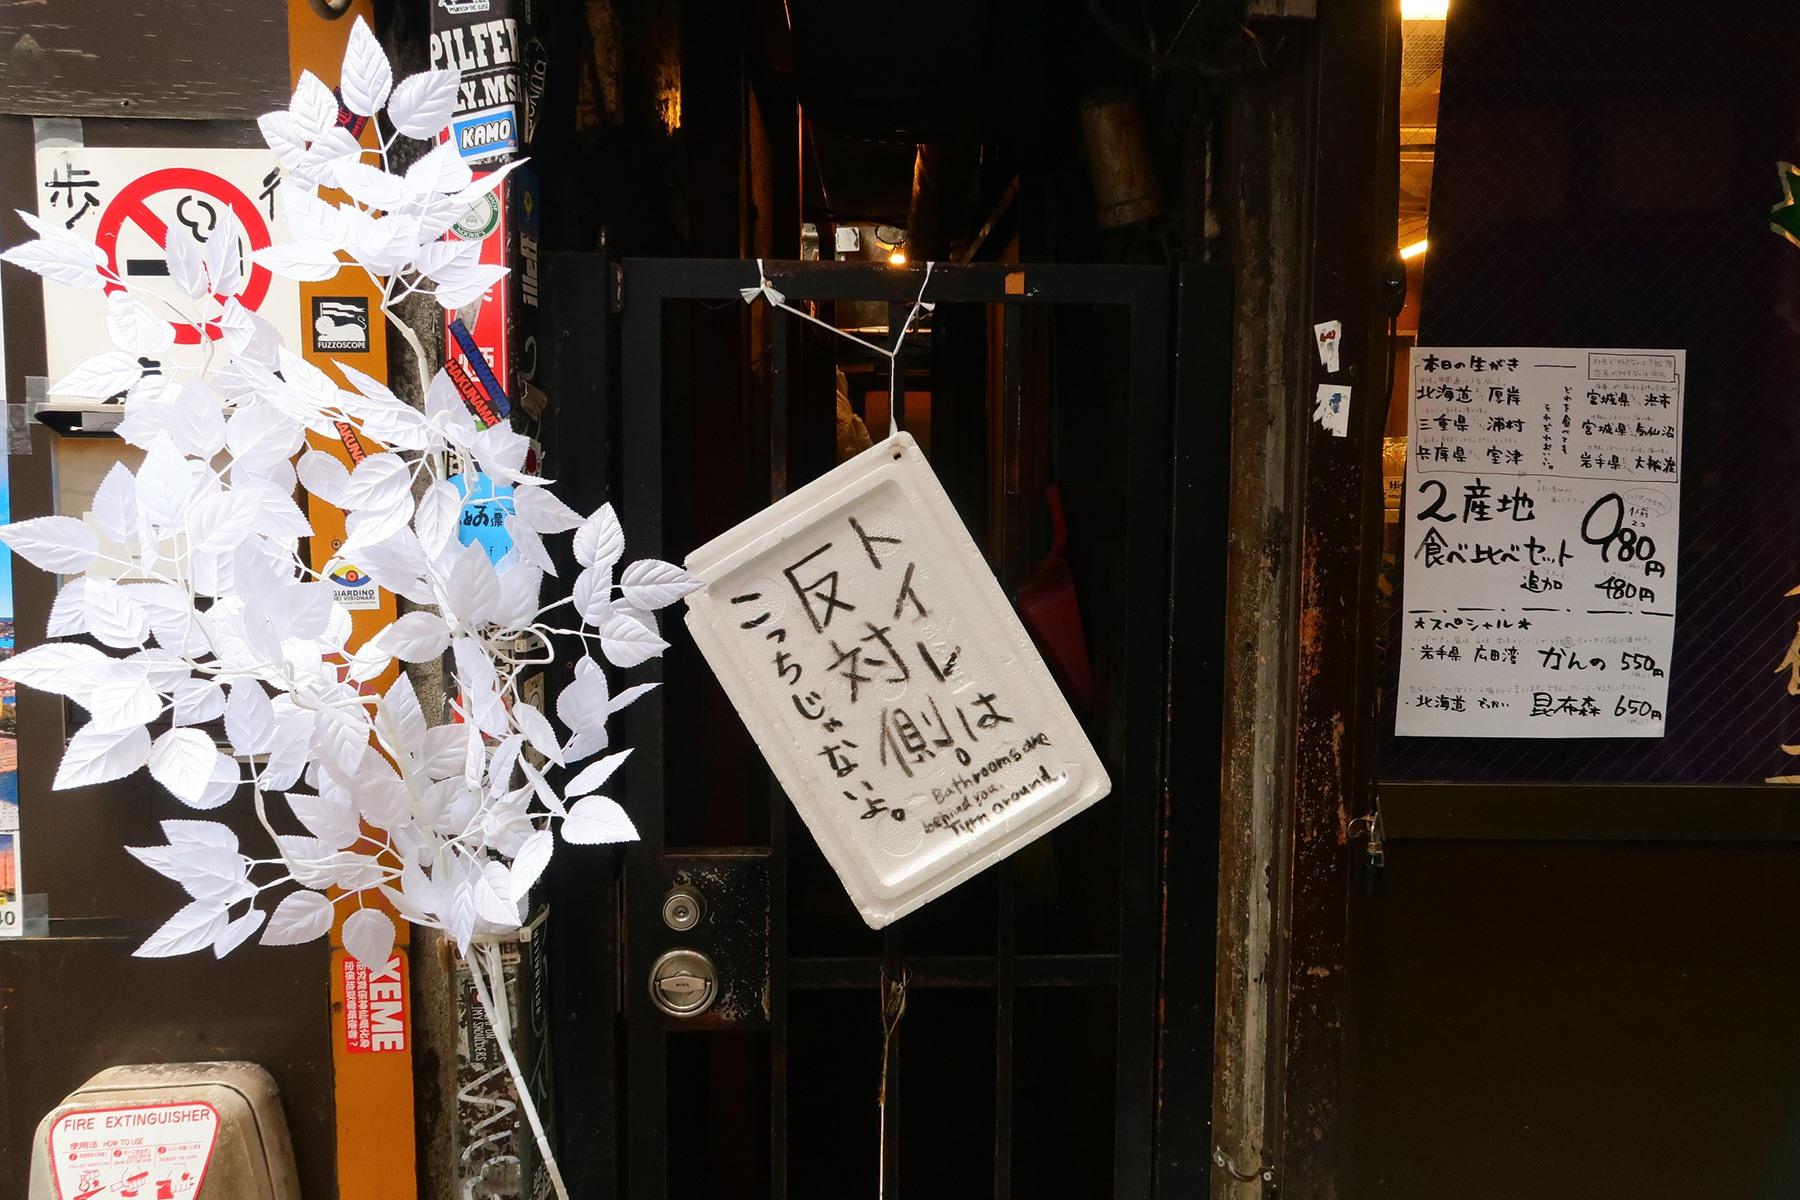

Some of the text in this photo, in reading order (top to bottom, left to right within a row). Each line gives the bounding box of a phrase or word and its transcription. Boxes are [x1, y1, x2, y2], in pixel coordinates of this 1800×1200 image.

[461, 119, 513, 149] KAMO
[45, 162, 100, 230] 歩
[318, 341, 366, 349] FUZZOSCOPE
[1422, 354, 1520, 373] 本日の生がき
[1416, 384, 1473, 404] 北海道
[1587, 390, 1630, 408] 宮城県
[1419, 412, 1526, 433] 三重県 浦村
[1581, 420, 1627, 438] 宮城県
[1416, 443, 1524, 466] 兵庫県 室津
[1580, 451, 1677, 474] 岩手県 大船渡
[1417, 478, 1536, 524] 2産地
[1415, 526, 1574, 568] 食べ比べセット
[1520, 570, 1563, 593] 追加
[1594, 576, 1655, 603] 480円
[1419, 646, 1462, 661] 岩手県
[1474, 648, 1520, 665] 広田湾
[1620, 651, 1665, 678] 550円
[1415, 694, 1467, 713] 北海道
[1529, 691, 1602, 717] 昆布森
[1614, 695, 1662, 721] 650円
[63, 1109, 211, 1132] FIRE EXTINGUISHER
[103, 1139, 119, 1148] HOW
[119, 1138, 130, 1147] TO
[130, 1137, 144, 1146] USE
